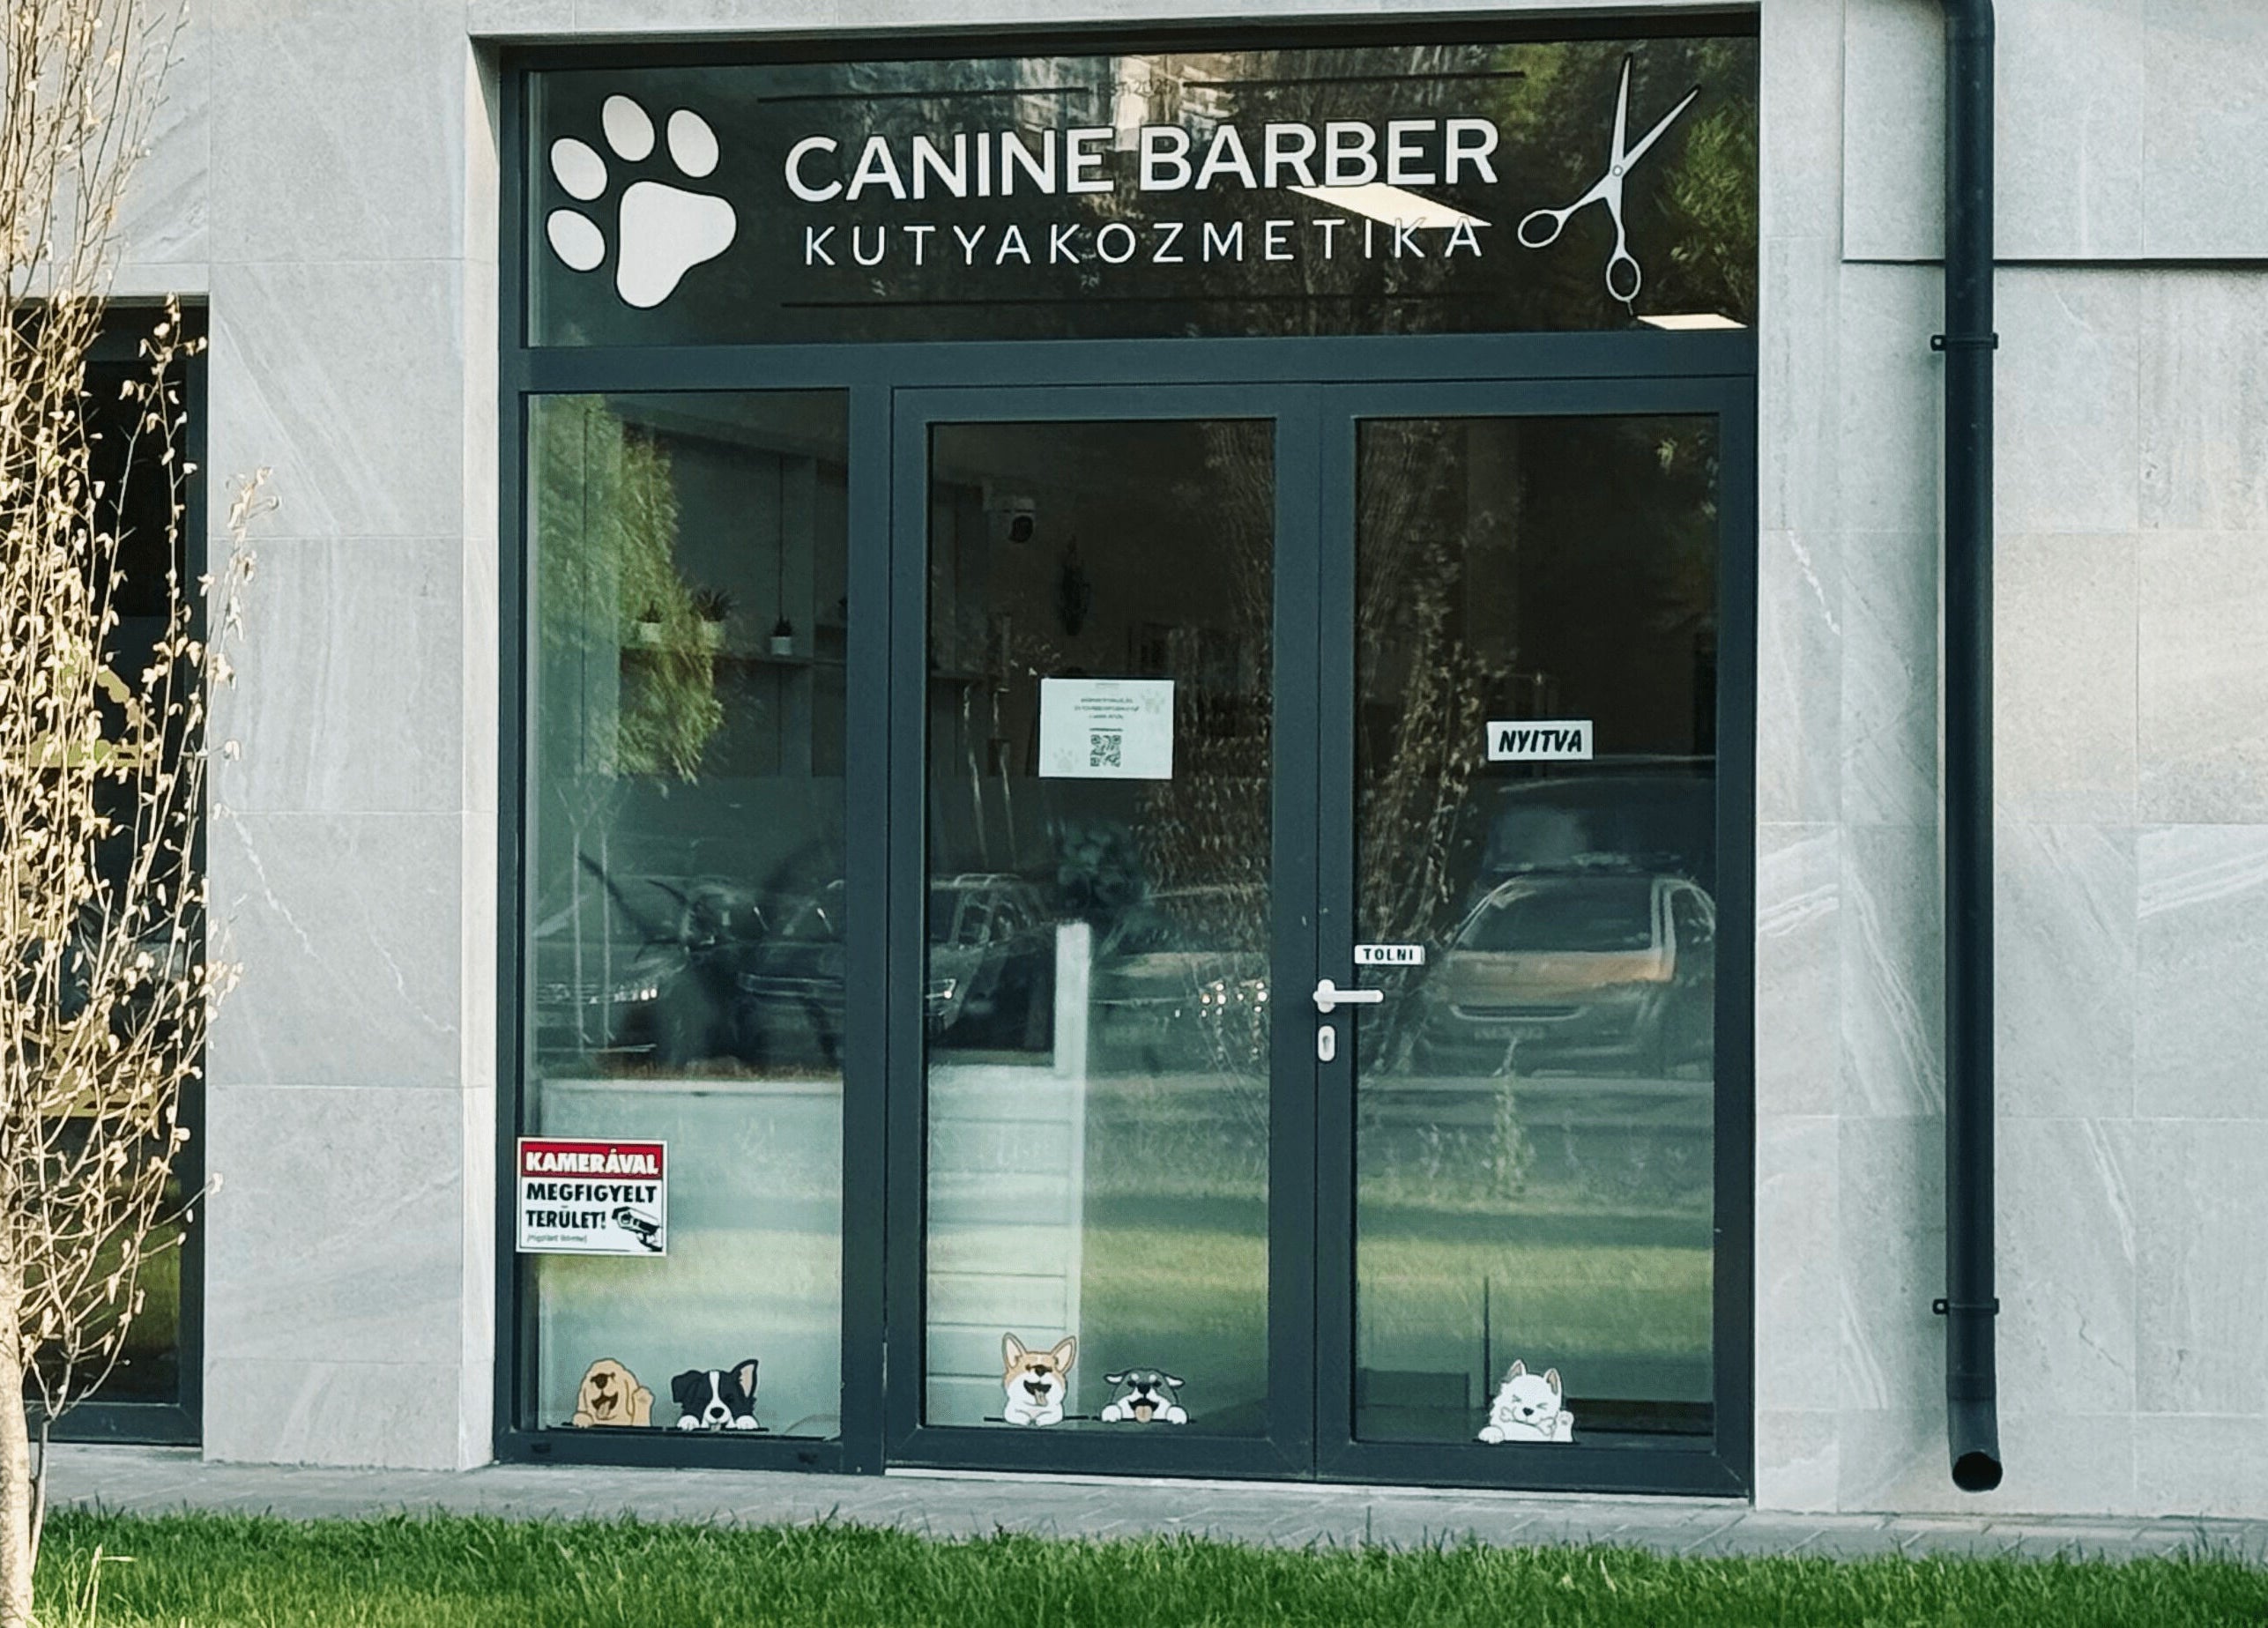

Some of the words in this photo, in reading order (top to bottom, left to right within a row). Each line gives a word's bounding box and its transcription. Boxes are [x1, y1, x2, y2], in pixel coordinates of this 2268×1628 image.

[785, 126, 1116, 202] CANINE
[1138, 118, 1499, 192] BARBER
[805, 217, 1483, 266] KUTYAKOZMETIKA
[1498, 729, 1582, 753] NYITVA
[1363, 948, 1413, 961] TOLNI
[525, 1148, 659, 1175] KAMERÁVAL
[526, 1183, 657, 1203] MEGFIGYELT
[525, 1205, 606, 1230] TERÜLET!
